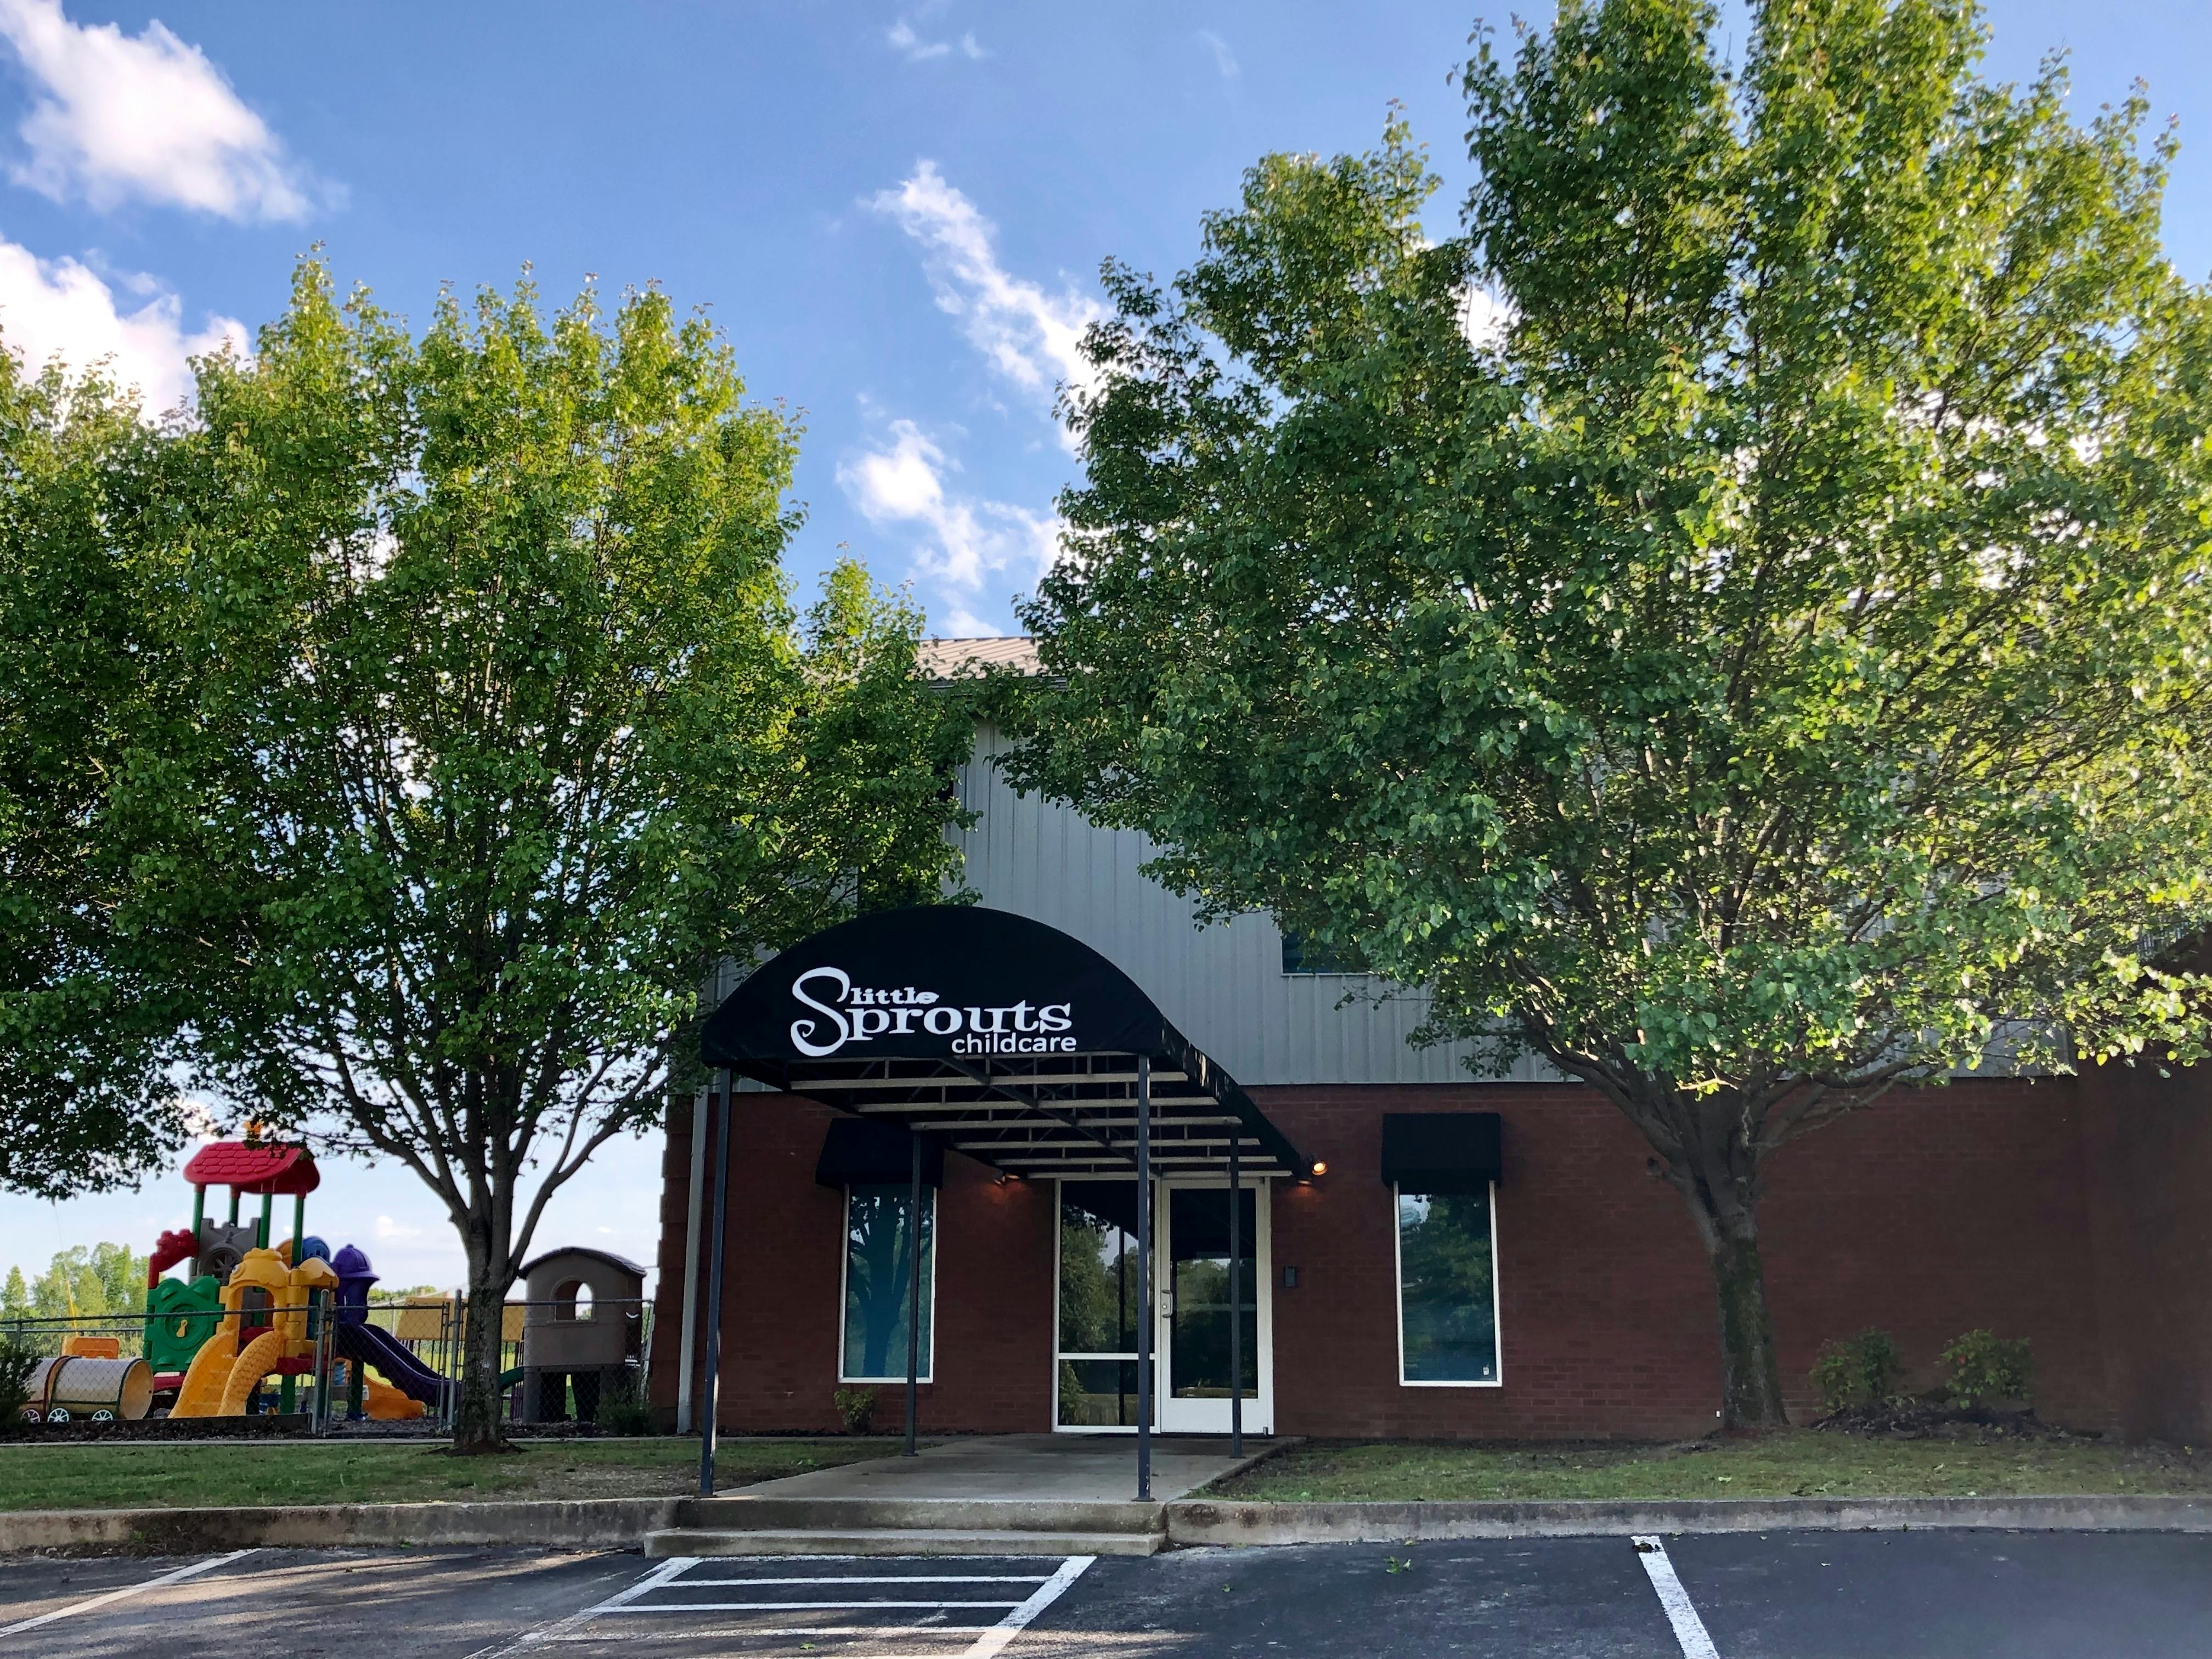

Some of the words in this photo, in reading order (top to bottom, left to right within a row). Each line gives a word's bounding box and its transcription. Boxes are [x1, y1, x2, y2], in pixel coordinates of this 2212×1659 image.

[850, 986, 940, 1005] little
[791, 966, 1073, 1057] Sprouts
[951, 1032, 1077, 1053] childcare
